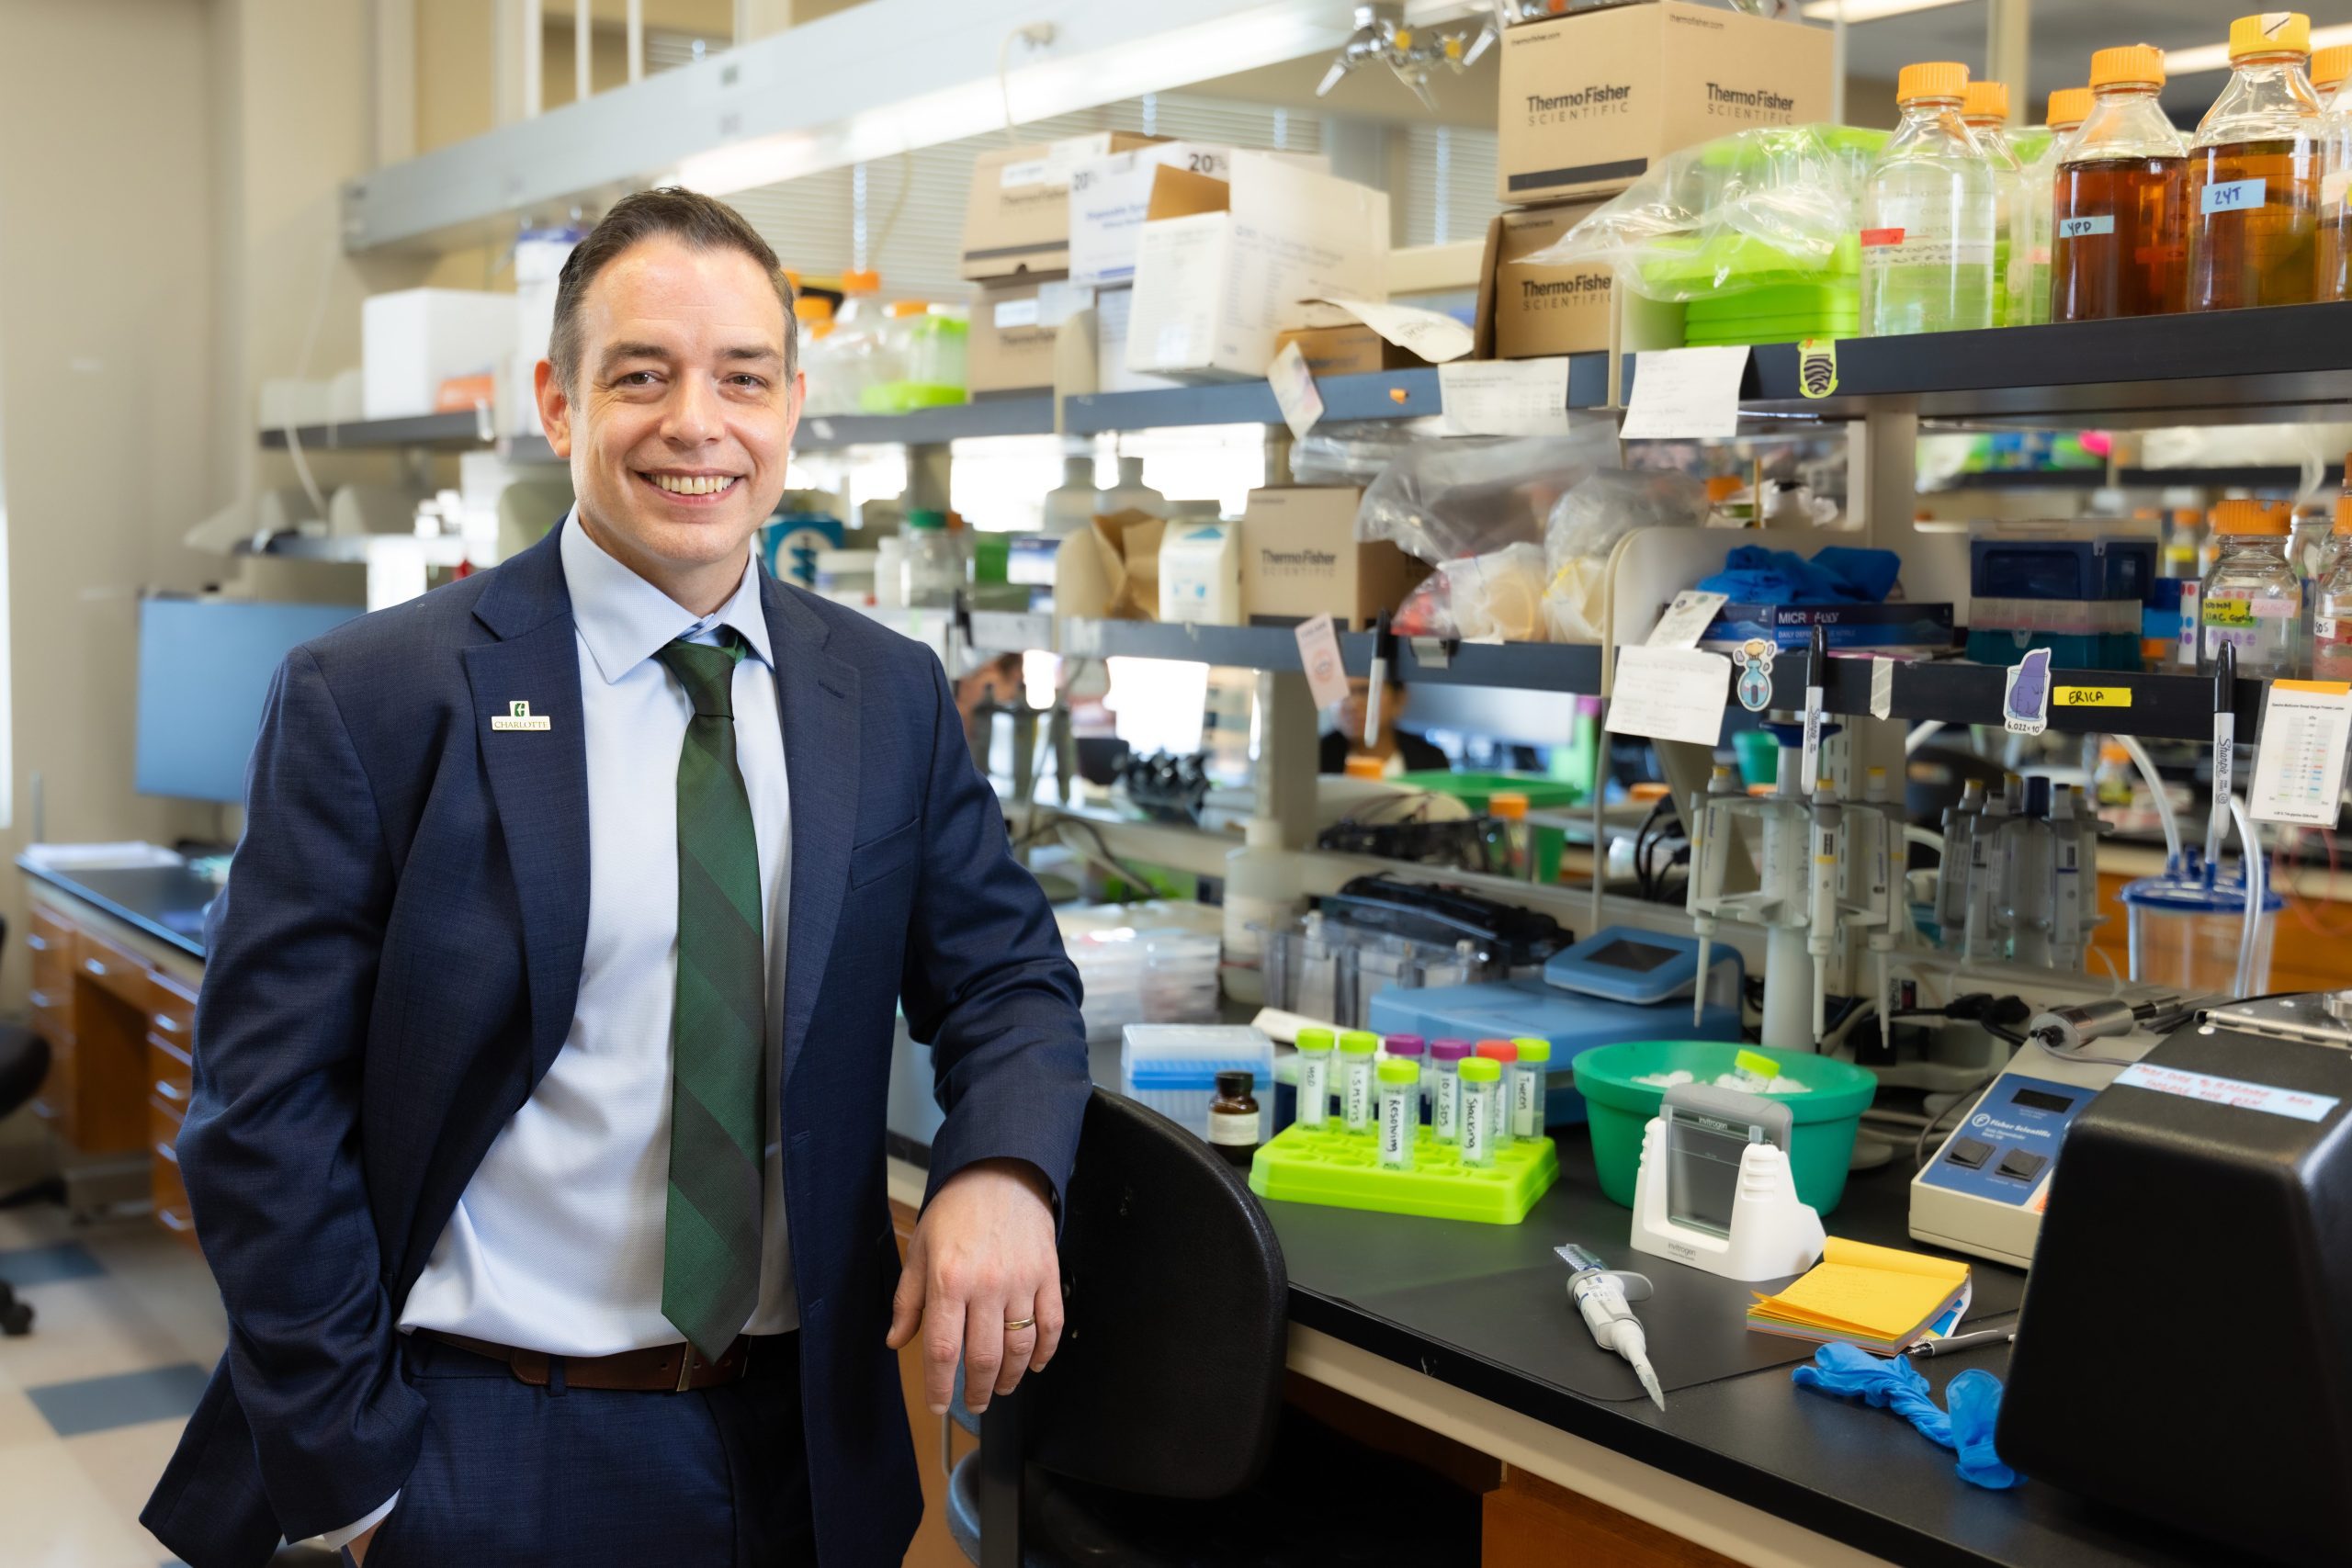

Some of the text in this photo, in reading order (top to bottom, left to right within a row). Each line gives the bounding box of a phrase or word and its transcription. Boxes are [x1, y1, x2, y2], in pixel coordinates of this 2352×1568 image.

[1528, 101, 1630, 127] SCIENTIFIC
[1707, 103, 1792, 126] SCIENTIFIC
[2067, 220, 2092, 237] YPD
[1521, 274, 1612, 298] ThermoFishe
[2068, 690, 2105, 705] ERICA
[494, 720, 548, 728] CHARLOTTE
[2218, 734, 2232, 775] Sharpie
[1518, 1076, 1531, 1111] Tween
[1464, 1098, 1478, 1150] Stacking
[1698, 1115, 1728, 1131] invitrogen
[1990, 1118, 2052, 1139] Fisher Scientific
[1668, 1242, 1697, 1258] invitrogen
